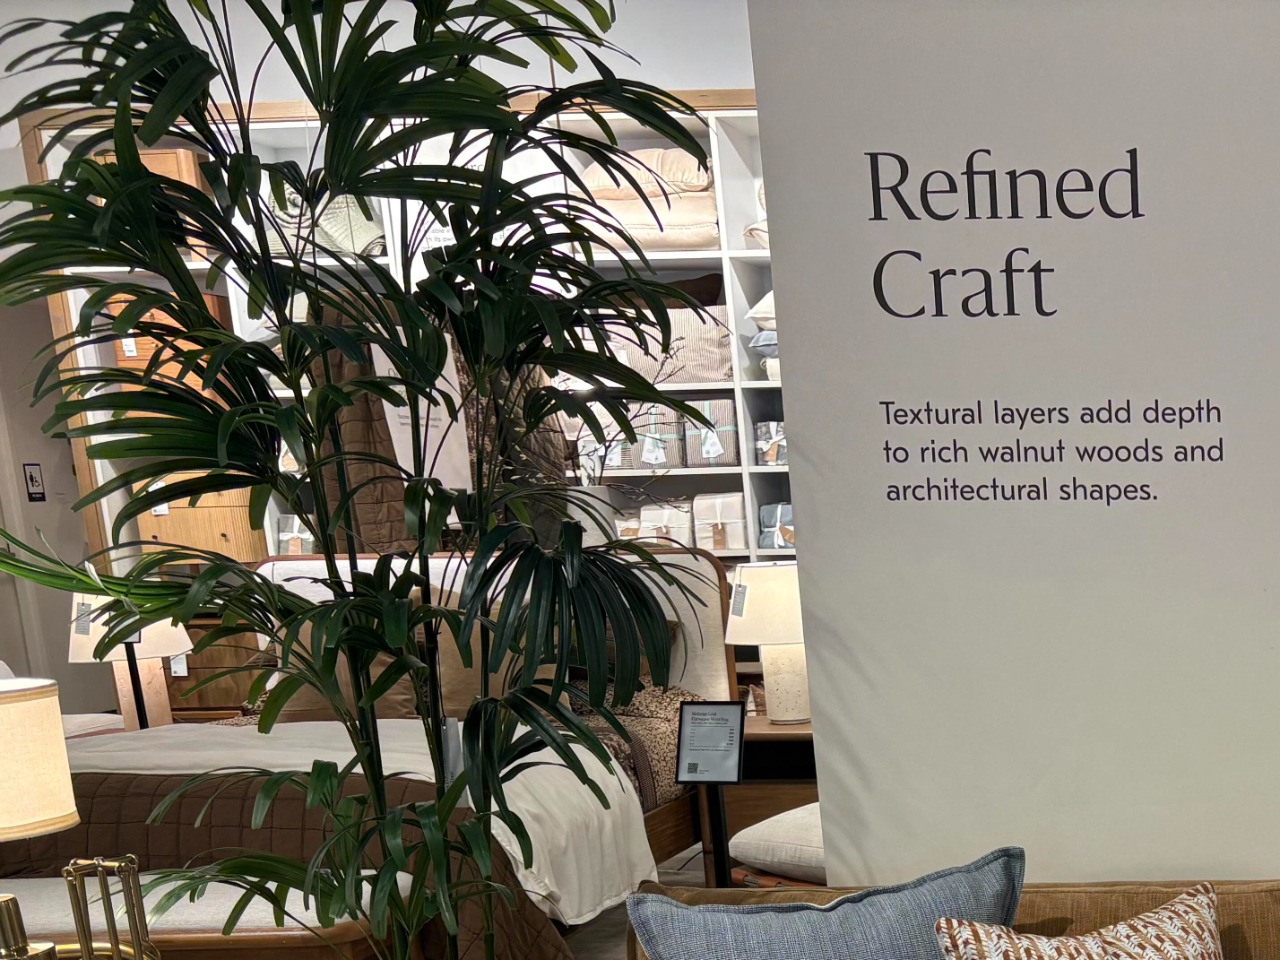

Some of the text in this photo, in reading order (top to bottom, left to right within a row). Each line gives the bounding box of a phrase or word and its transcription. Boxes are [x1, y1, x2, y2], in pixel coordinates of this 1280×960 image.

[864, 147, 1146, 221] Refined
[873, 247, 1057, 318] Craft
[879, 399, 1222, 430] Textural layers add depth
[883, 437, 1224, 463] to rich walnut woods and
[886, 477, 1158, 506] architectural shapes.
